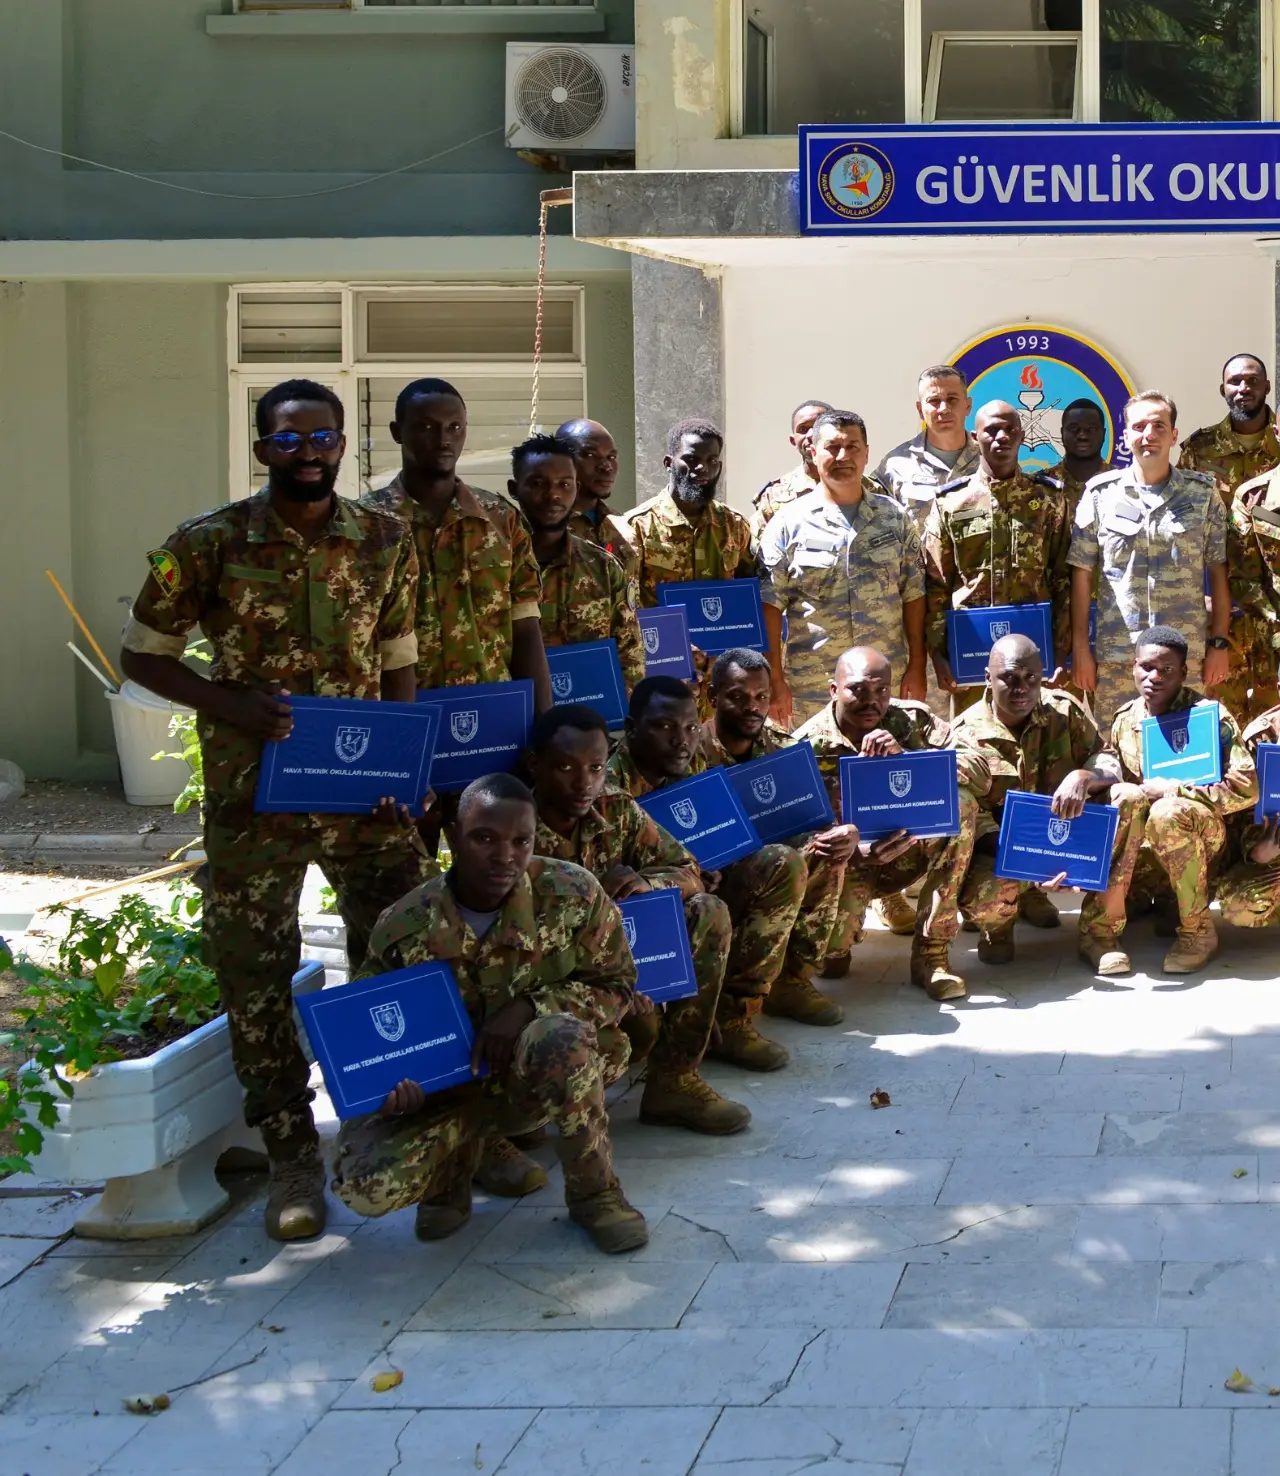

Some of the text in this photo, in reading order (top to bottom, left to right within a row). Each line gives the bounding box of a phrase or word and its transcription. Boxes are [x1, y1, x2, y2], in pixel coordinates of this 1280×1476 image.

[620, 53, 632, 86] arçelik
[915, 154, 1154, 204] GÜVENLİK
[837, 206, 870, 216] OKULLARI
[1005, 336, 1050, 352] 1993
[363, 770, 410, 778] KOMUTANLIĞI
